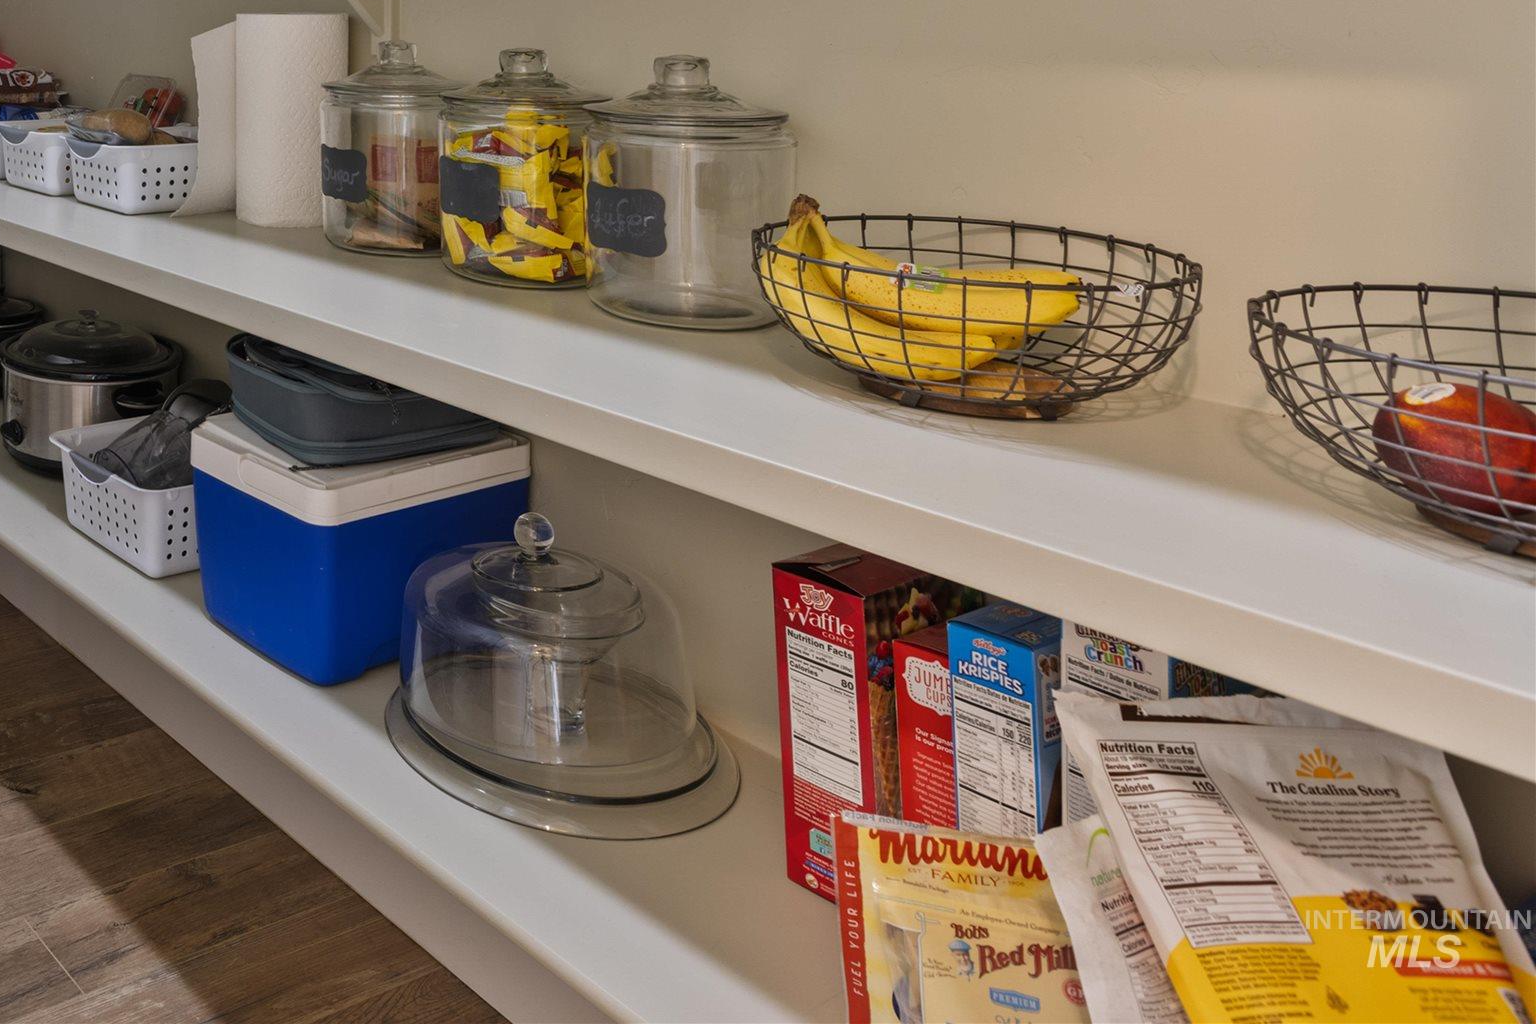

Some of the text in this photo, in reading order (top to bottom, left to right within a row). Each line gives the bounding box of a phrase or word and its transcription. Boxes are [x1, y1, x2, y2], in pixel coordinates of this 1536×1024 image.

[323, 158, 361, 195] Sugar
[782, 596, 855, 639] Waffle
[786, 628, 853, 660] Nutrition Facts
[821, 630, 855, 647] CONES
[972, 638, 1007, 656] Kellogg's
[1091, 638, 1131, 659] Toast
[971, 650, 1009, 676] RICE
[1084, 643, 1145, 673] Crunch
[789, 660, 854, 691] Calories 80
[958, 659, 1024, 696] KRISPIES
[925, 685, 952, 707] CUPS
[914, 726, 929, 737] Our
[1002, 727, 1015, 740] 150
[1018, 733, 1032, 746] 220
[1099, 742, 1196, 755] Nutrition Facts
[1105, 763, 1131, 771] Serving
[1113, 780, 1216, 793] Calories 110
[1267, 779, 1401, 800] The Catalina Story
[930, 868, 1001, 887] FAMILY
[844, 859, 865, 998] FUEL YOUR LIFE
[950, 922, 990, 940] Bob's
[975, 943, 1026, 979] Red
[992, 990, 1039, 1010] PREMIUM
